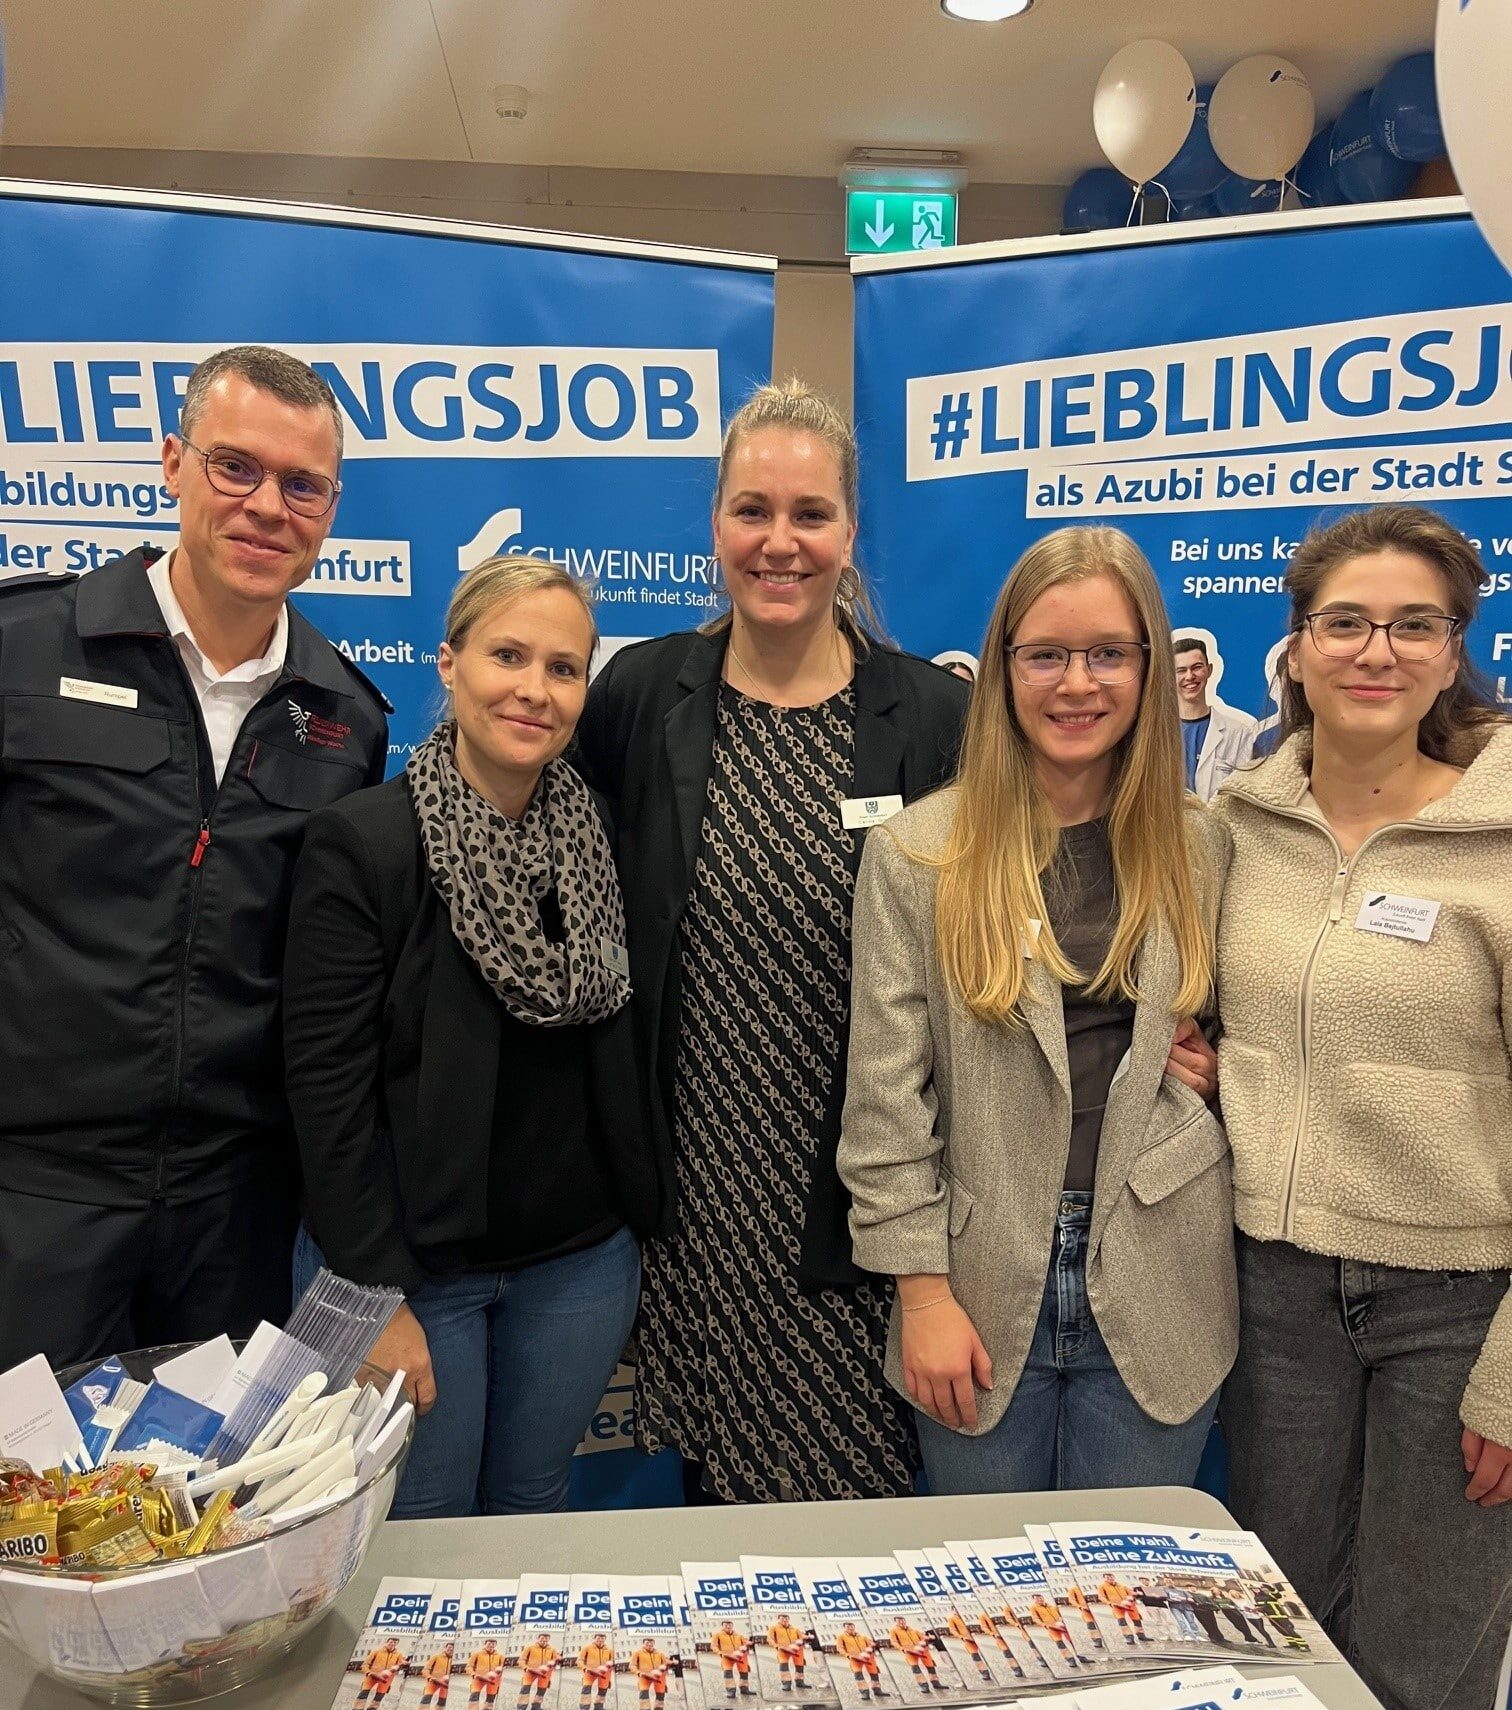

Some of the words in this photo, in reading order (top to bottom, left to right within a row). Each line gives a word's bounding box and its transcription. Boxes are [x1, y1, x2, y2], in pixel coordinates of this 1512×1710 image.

[931, 325, 1512, 460] #LIEBLINGSJ
[1035, 474, 1084, 507] als
[1095, 467, 1203, 505] Azubi
[1216, 462, 1276, 499] bei
[1290, 459, 1360, 494] der
[1371, 451, 1484, 491] Stadt
[1170, 537, 1209, 562] Bei
[1217, 540, 1264, 561] uns
[508, 545, 719, 586] HWEINFURT
[640, 590, 680, 605] findet
[684, 590, 719, 608] Stadt
[338, 638, 415, 664] Arbeit
[1379, 902, 1430, 917] SCHWEINFURT
[1075, 1536, 1124, 1549] Deine
[1127, 1536, 1175, 1548] Wahl.
[998, 1557, 1038, 1568] Dein
[1076, 1549, 1141, 1563] Deine
[1145, 1549, 1235, 1568] Zukunft.
[628, 1597, 672, 1609] Dein
